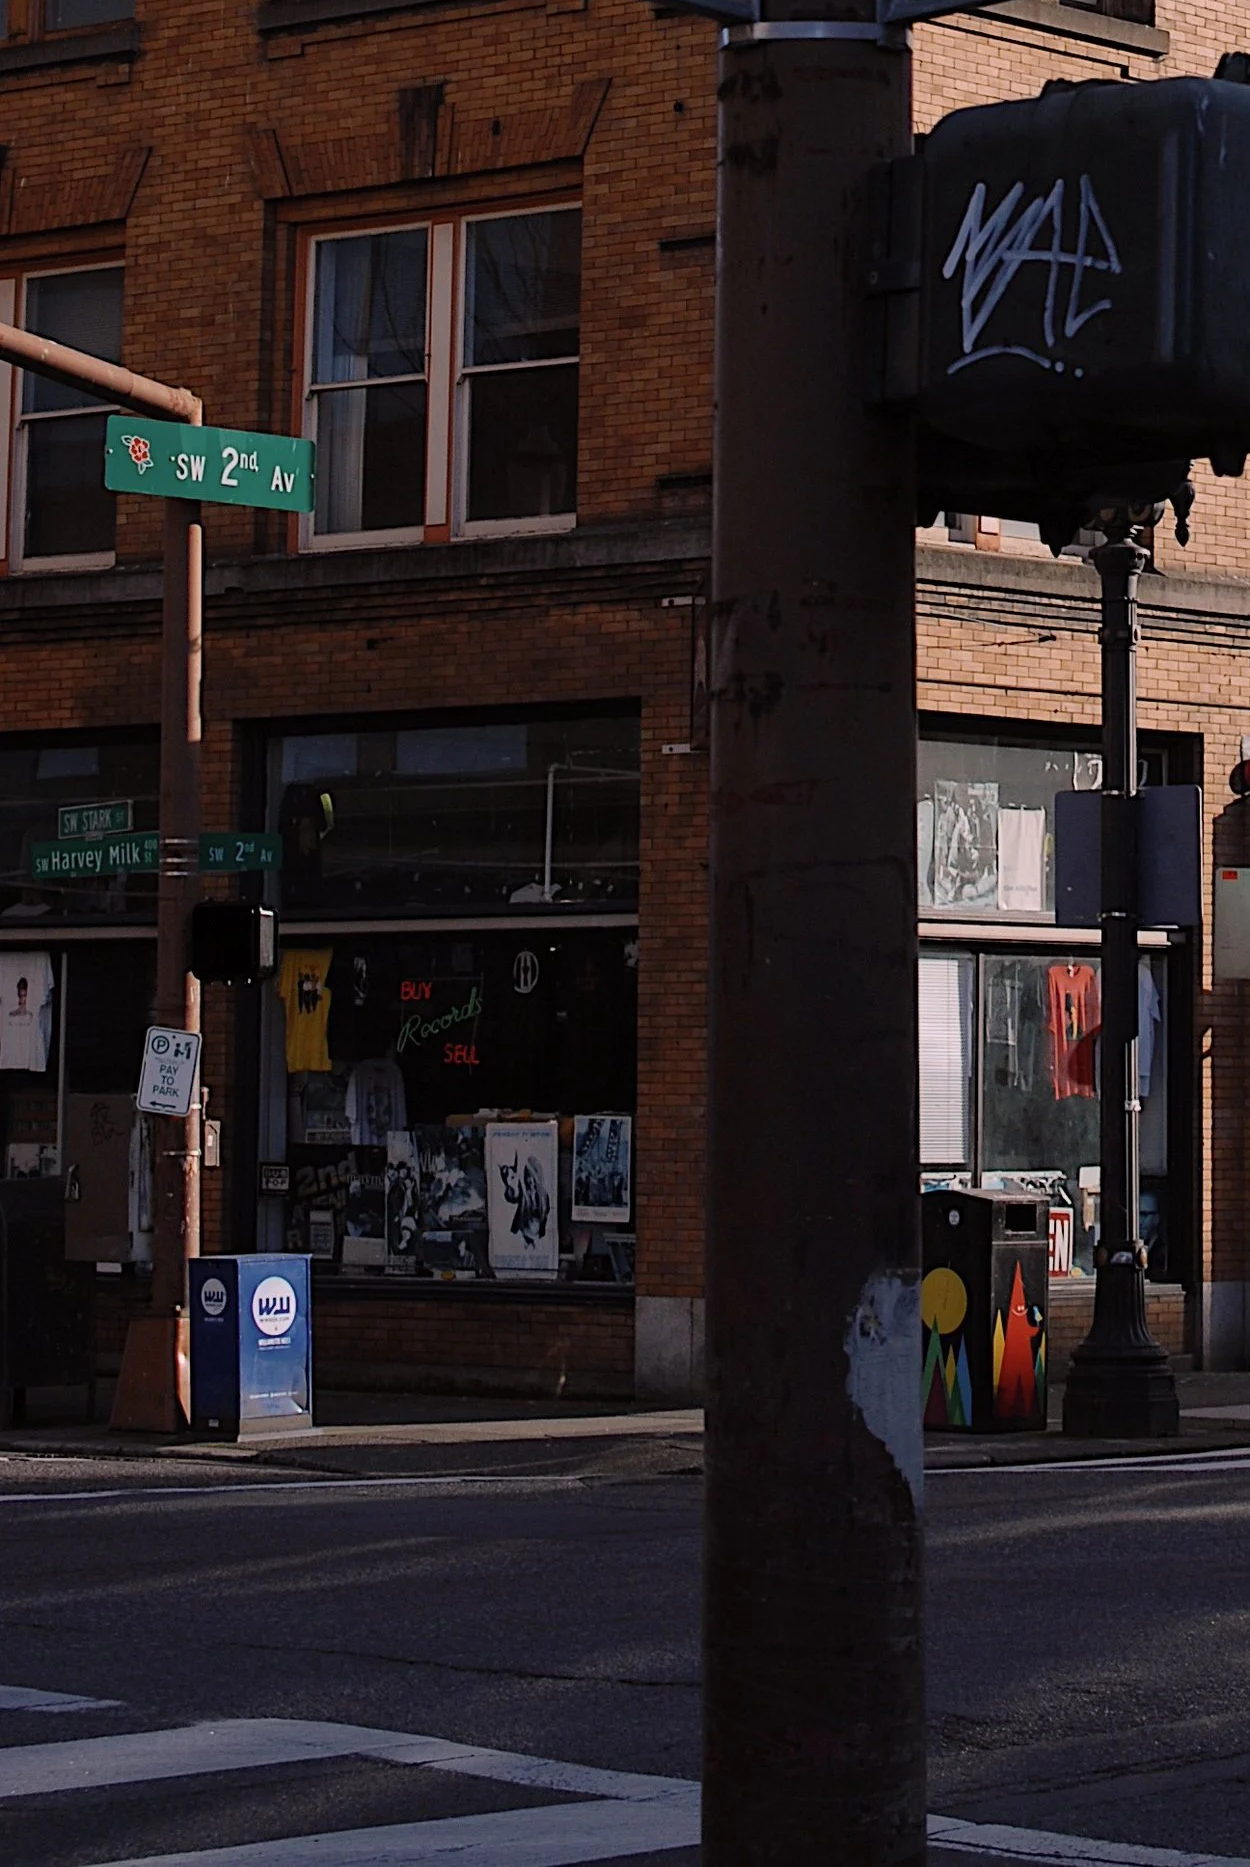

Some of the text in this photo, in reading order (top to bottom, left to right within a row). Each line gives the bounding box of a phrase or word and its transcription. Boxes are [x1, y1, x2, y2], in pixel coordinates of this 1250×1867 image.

[175, 446, 295, 493] SW 2nd Av
[63, 813, 77, 833] SW
[81, 810, 112, 831] STARK
[35, 857, 49, 873] SW
[51, 848, 102, 872] Harvey
[109, 842, 140, 865] Milk
[208, 841, 274, 862] SW 2nd Av
[401, 981, 433, 1000] BUY
[156, 1039, 166, 1052] P
[443, 1044, 480, 1064] SELL
[159, 1063, 180, 1077] PAY
[161, 1075, 175, 1086] TO
[152, 1084, 180, 1098] PARK
